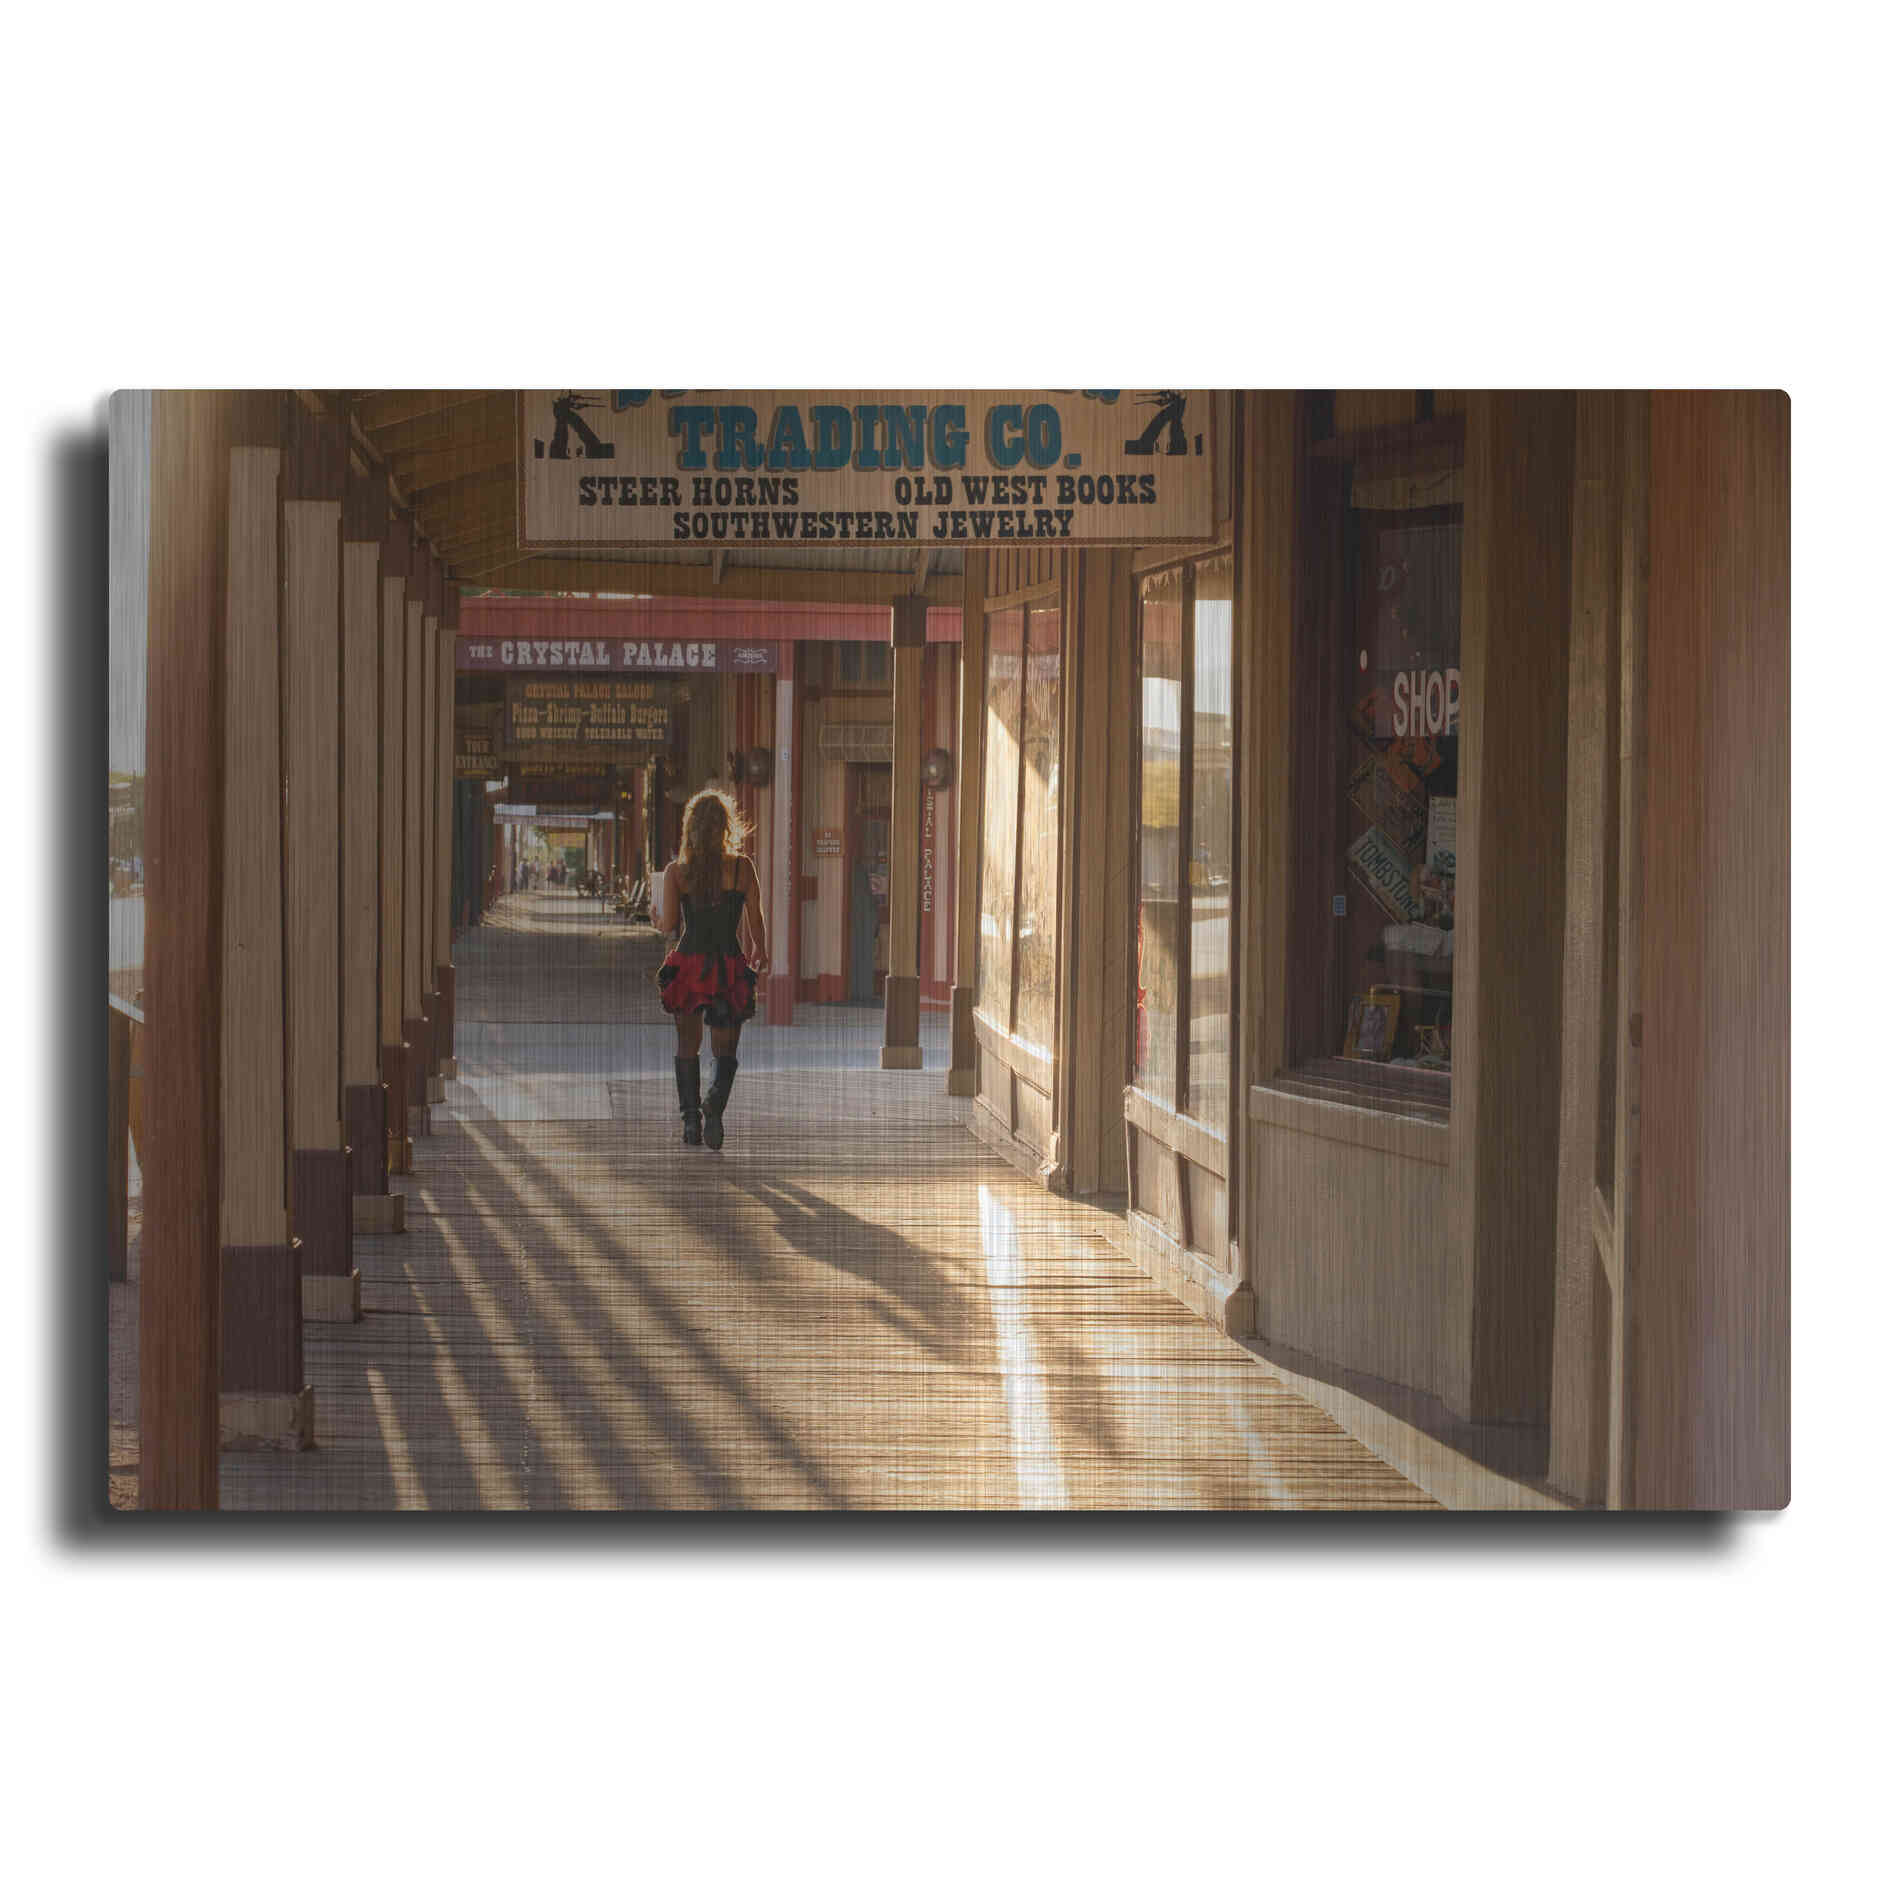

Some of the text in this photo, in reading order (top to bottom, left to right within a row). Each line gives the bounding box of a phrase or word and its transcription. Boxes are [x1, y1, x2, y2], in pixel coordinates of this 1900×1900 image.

[669, 402, 1082, 471] TRADING CO.
[578, 477, 800, 506] STEER HORNS
[895, 473, 1157, 506] OLD WEST BOOKS
[673, 509, 1074, 540] SOUTHWESTERN JEWELRY
[469, 641, 717, 668] THE CRYSTAL PALACE
[1393, 668, 1460, 737] SHOP
